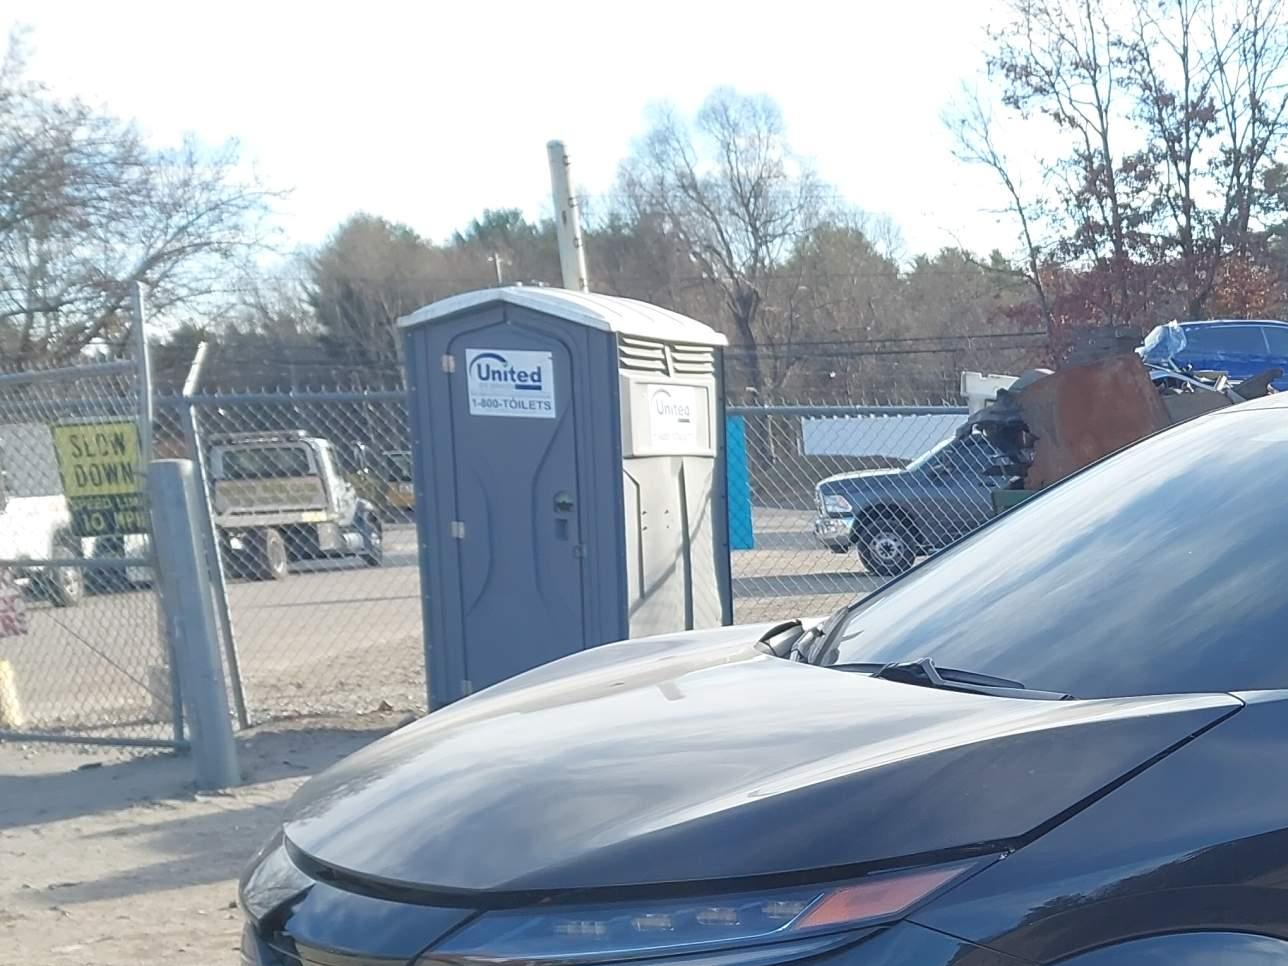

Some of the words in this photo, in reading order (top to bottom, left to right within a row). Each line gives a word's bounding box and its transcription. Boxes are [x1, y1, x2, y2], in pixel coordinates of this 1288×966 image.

[477, 363, 542, 383] United
[472, 398, 552, 410] 1-800-TOILETS
[655, 399, 690, 417] United
[69, 432, 125, 458] SLOW
[74, 463, 134, 488] DOWN
[81, 512, 105, 531] 10
